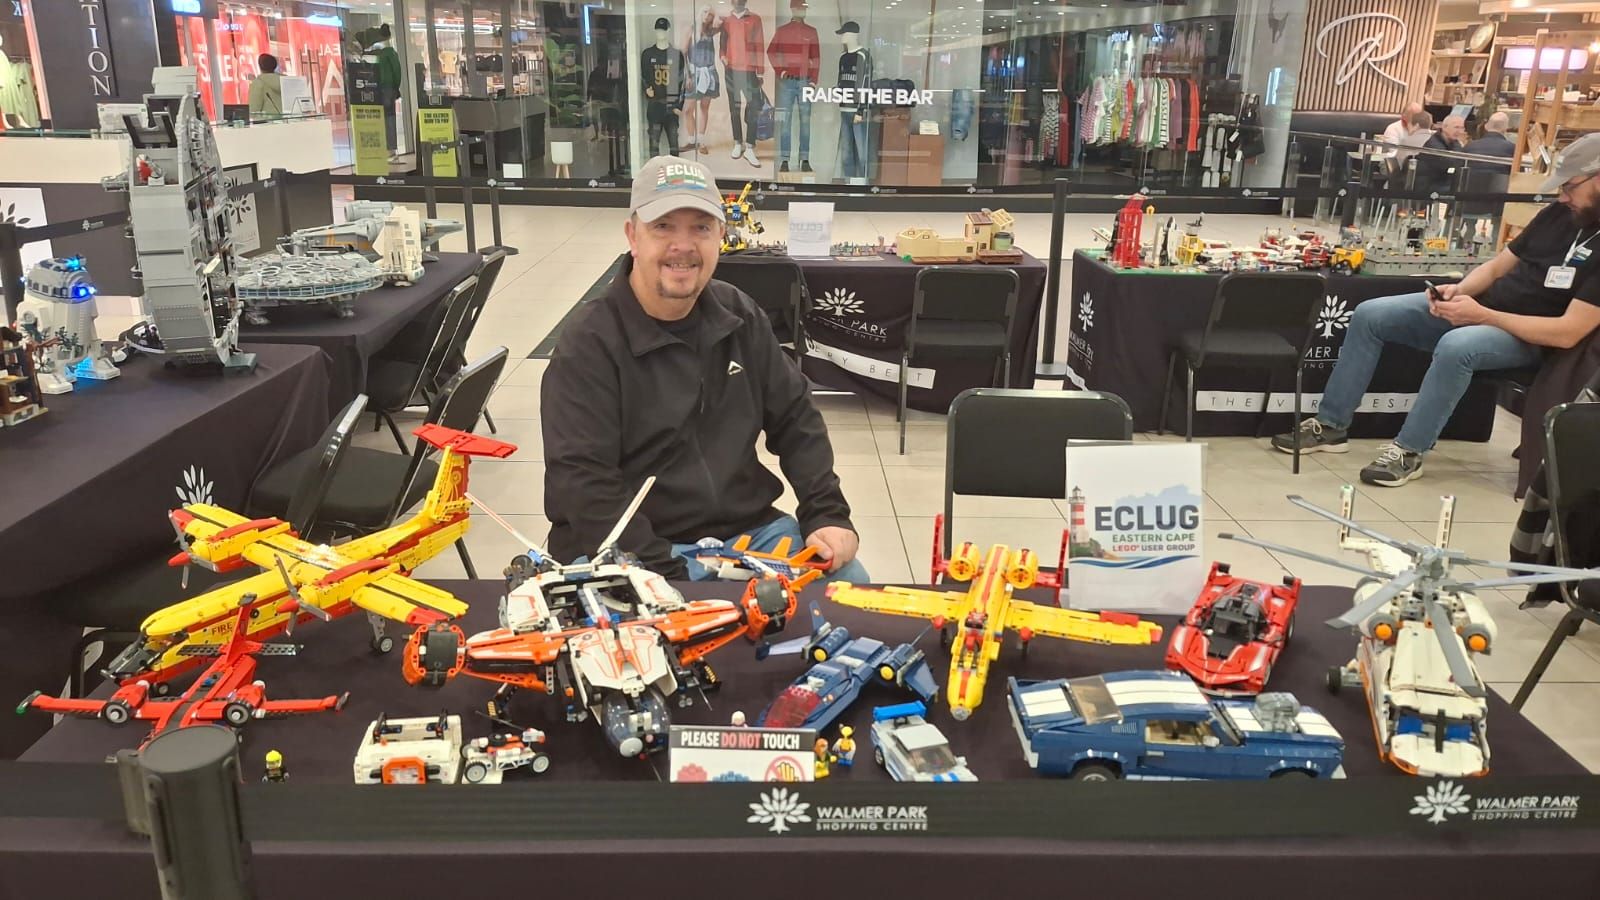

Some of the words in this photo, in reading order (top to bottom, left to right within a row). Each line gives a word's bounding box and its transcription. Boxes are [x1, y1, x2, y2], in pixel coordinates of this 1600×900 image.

[79, 0, 112, 96] TION
[198, 55, 234, 82] SLE
[655, 70, 669, 86] 99
[802, 87, 855, 103] RAISE
[857, 88, 893, 104] THE
[896, 89, 933, 105] BAR
[850, 320, 888, 336] PARK
[869, 364, 923, 382] BET
[1210, 397, 1253, 408] THE
[1095, 505, 1199, 531] ECLUG
[1112, 534, 1162, 543] EASTERN
[1166, 533, 1196, 542] CAPE
[1141, 544, 1164, 552] USER
[1166, 543, 1196, 551] GROUP
[681, 731, 720, 747] PLEASE
[721, 732, 737, 747] DO
[739, 732, 761, 748] NOT
[762, 733, 800, 750] TOUCH
[1476, 796, 1539, 809] WALMER
[1541, 796, 1580, 808] PARK
[816, 806, 884, 819] WALMER
[887, 806, 928, 818] PARK
[1472, 812, 1529, 821] SHOPPING
[1534, 811, 1577, 819] CENTRE
[816, 823, 878, 831] SHOPPING
[883, 822, 928, 831] CENTRE
